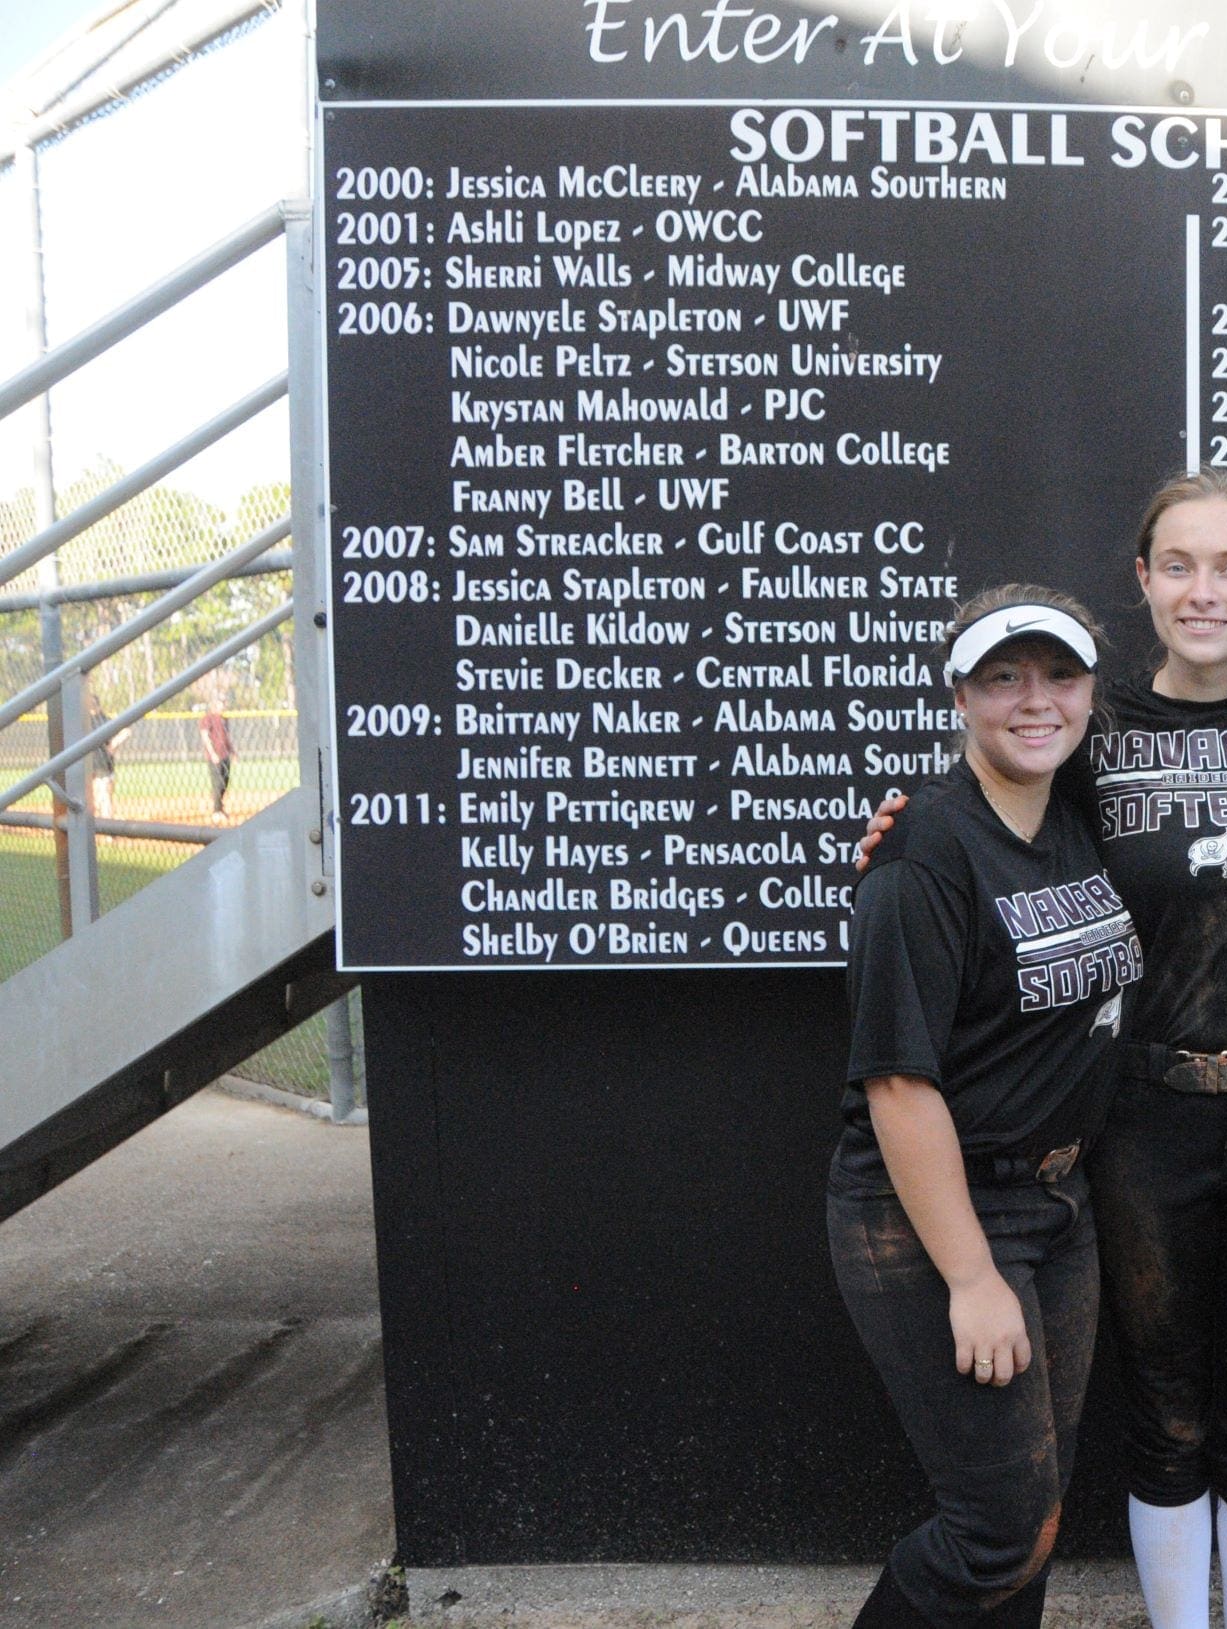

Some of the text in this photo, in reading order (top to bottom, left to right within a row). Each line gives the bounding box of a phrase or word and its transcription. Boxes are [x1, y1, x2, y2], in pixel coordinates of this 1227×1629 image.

[584, 0, 838, 63] Enter
[860, 0, 964, 65] At
[998, 0, 1210, 72] Your
[729, 108, 1085, 167] SOFTBALL
[336, 163, 1007, 205] 2000: Jessica McCleery Alabama Southern
[337, 209, 763, 251] 2001: Ashli Lopez OWCC
[337, 252, 906, 295] 2005: Sherri Walls Midway College
[338, 297, 849, 340] 2006: Dawnyele Stapleton UWF
[451, 342, 943, 384] Nicole Peltz Stetson University
[451, 386, 826, 431] Krystan Mahowald PJC
[450, 430, 950, 473] Amber Fletcher Barton College
[453, 477, 729, 519] Franny Bell UWF
[342, 520, 925, 559] 2007: Sam Streacker Gulf Coast CC
[343, 565, 958, 608] 2008: Jessica Stapleton Faulkner State
[455, 609, 956, 646] Danielle Kildow Stetson Univer
[456, 657, 544, 692] Stevie
[556, 655, 662, 690] Decker
[696, 654, 813, 689] Central
[824, 653, 933, 688] Florida
[347, 697, 970, 742] 2009: Brittany Naker Alabama Souther
[456, 741, 962, 780] Jennifer Bennett Alabama South
[350, 786, 874, 831] 2011: Emily Pettigrew Pensacola
[461, 831, 865, 875] Kelly Hayes Pensacola Sta
[461, 875, 855, 917] Chandler Bridges Colleg
[995, 874, 1124, 940] NAVAR
[462, 922, 558, 963] Shelby
[569, 921, 688, 955] O'Brien
[723, 921, 827, 957] Queens
[1017, 934, 1143, 1013] SOFTBA
